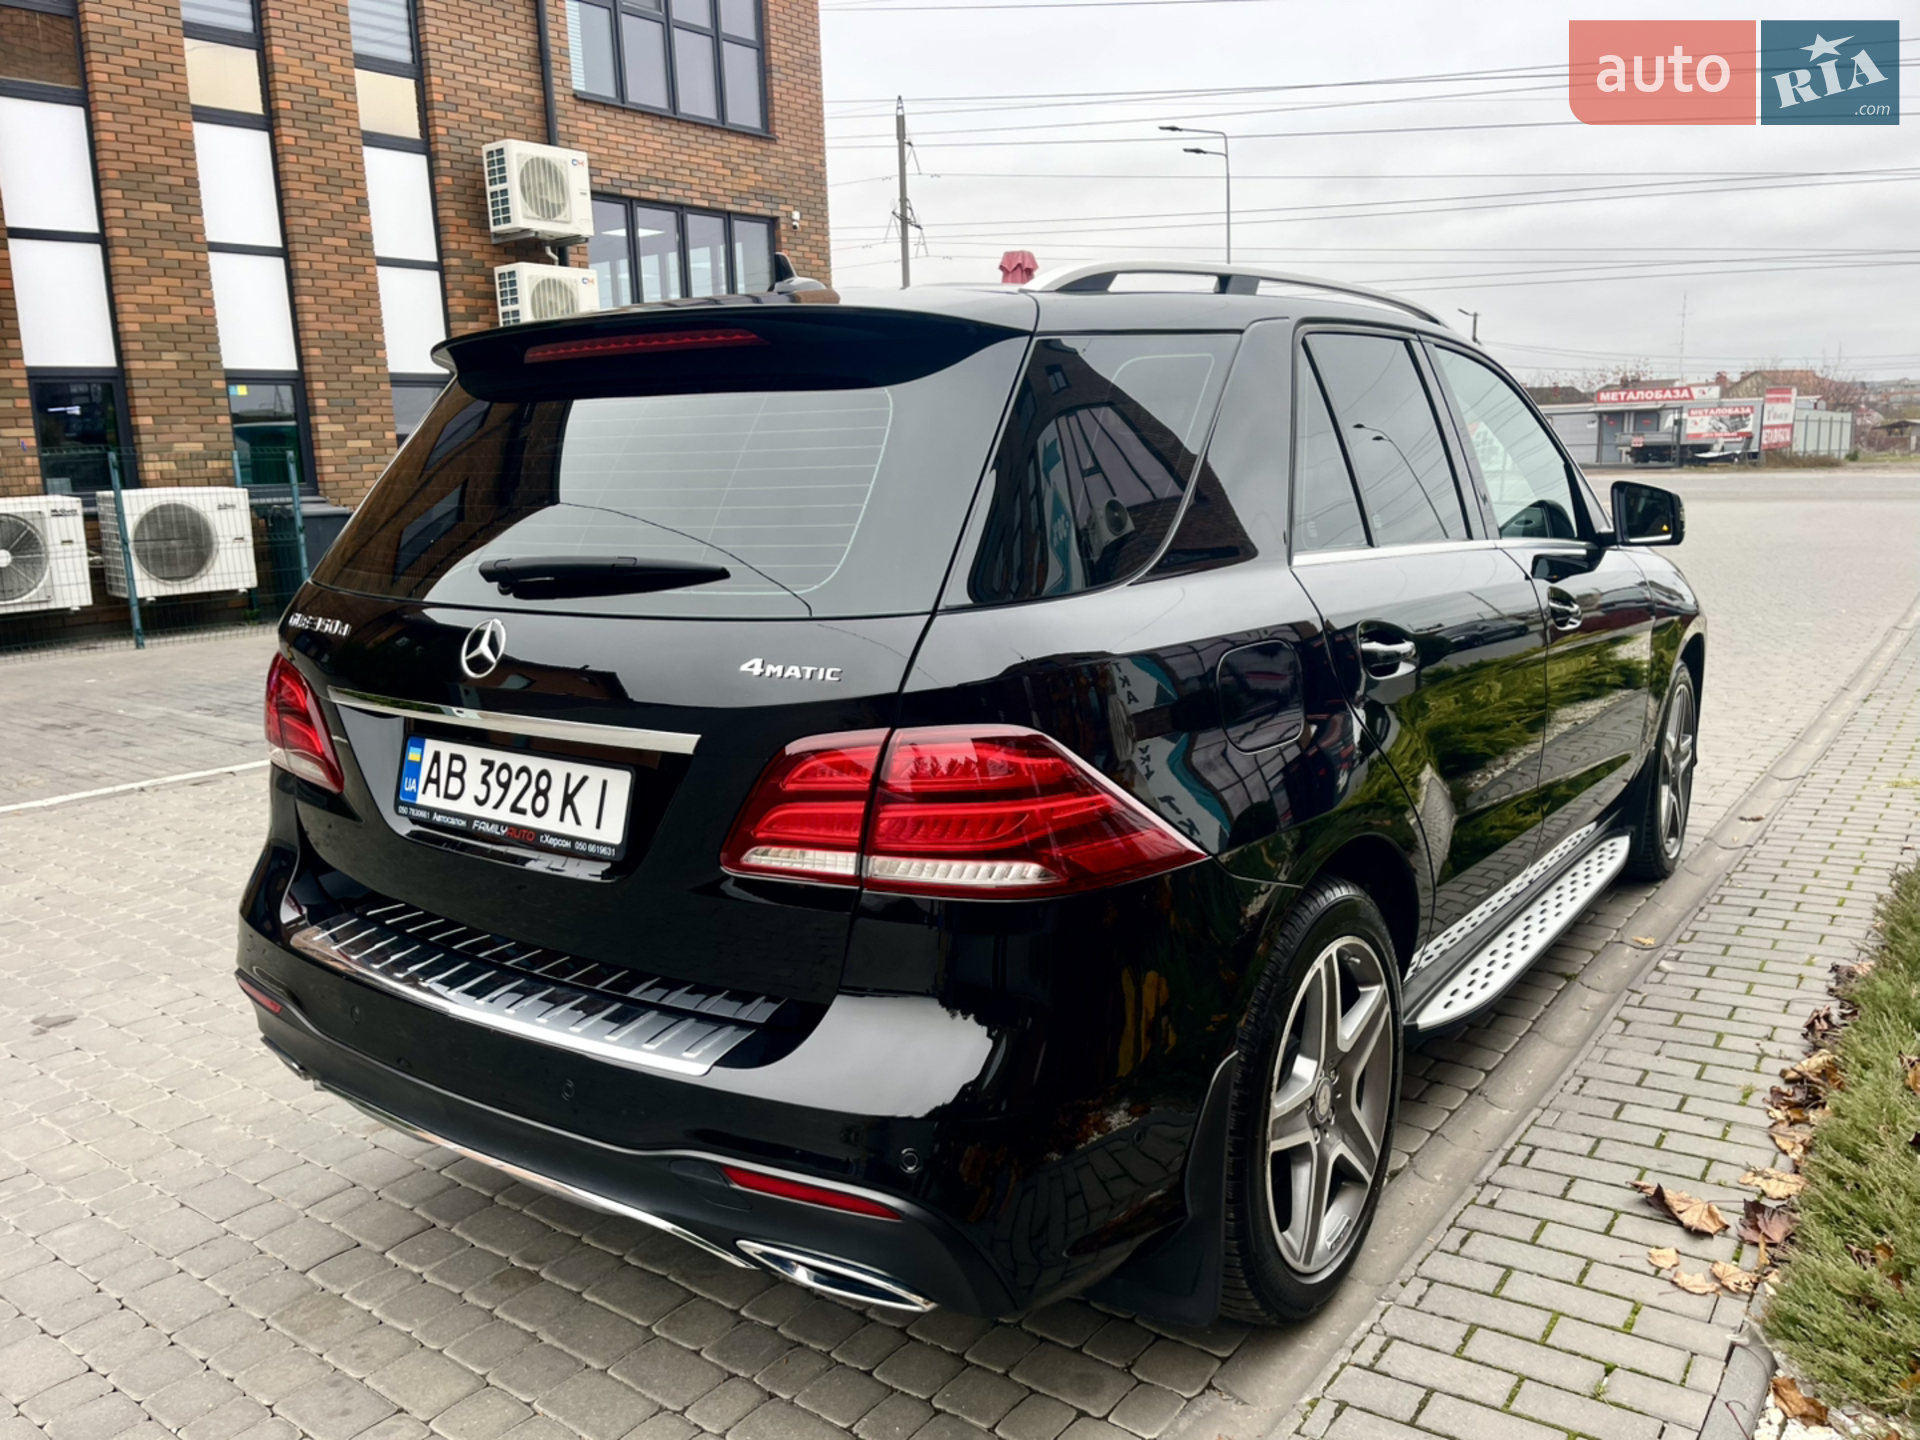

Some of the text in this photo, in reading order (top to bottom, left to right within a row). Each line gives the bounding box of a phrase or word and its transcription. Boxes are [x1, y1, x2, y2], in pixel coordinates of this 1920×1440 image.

[1600, 388, 1690, 402] МЕТАЛОБАЗА
[1690, 406, 1752, 416] МЕТАЛОБАЗА
[740, 657, 843, 681] 4MATIC
[404, 777, 417, 793] UA
[422, 750, 608, 830] AB 3928 KI
[432, 811, 467, 827] Автосалон
